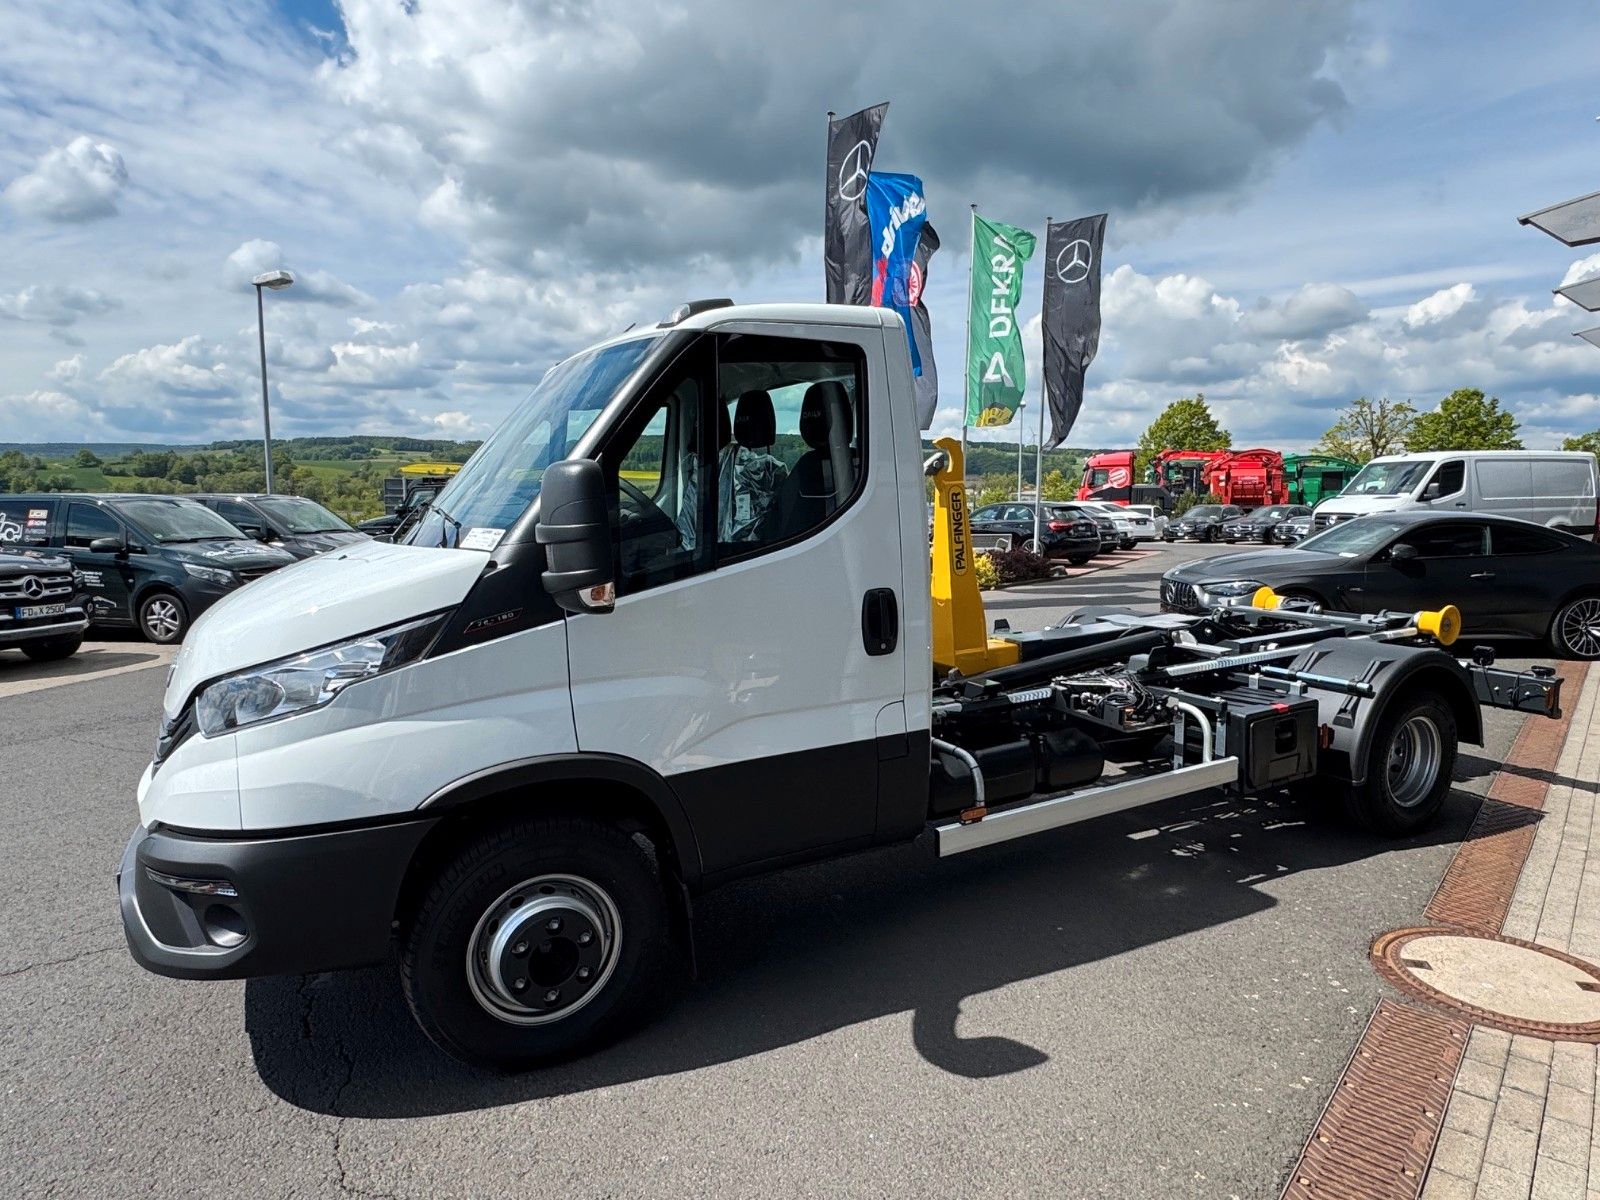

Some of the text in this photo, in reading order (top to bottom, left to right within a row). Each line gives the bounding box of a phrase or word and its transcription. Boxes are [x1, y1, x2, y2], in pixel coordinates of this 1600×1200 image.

[951, 491, 966, 570] PALFINGER
[22, 608, 33, 617] FD
[39, 606, 44, 615] X
